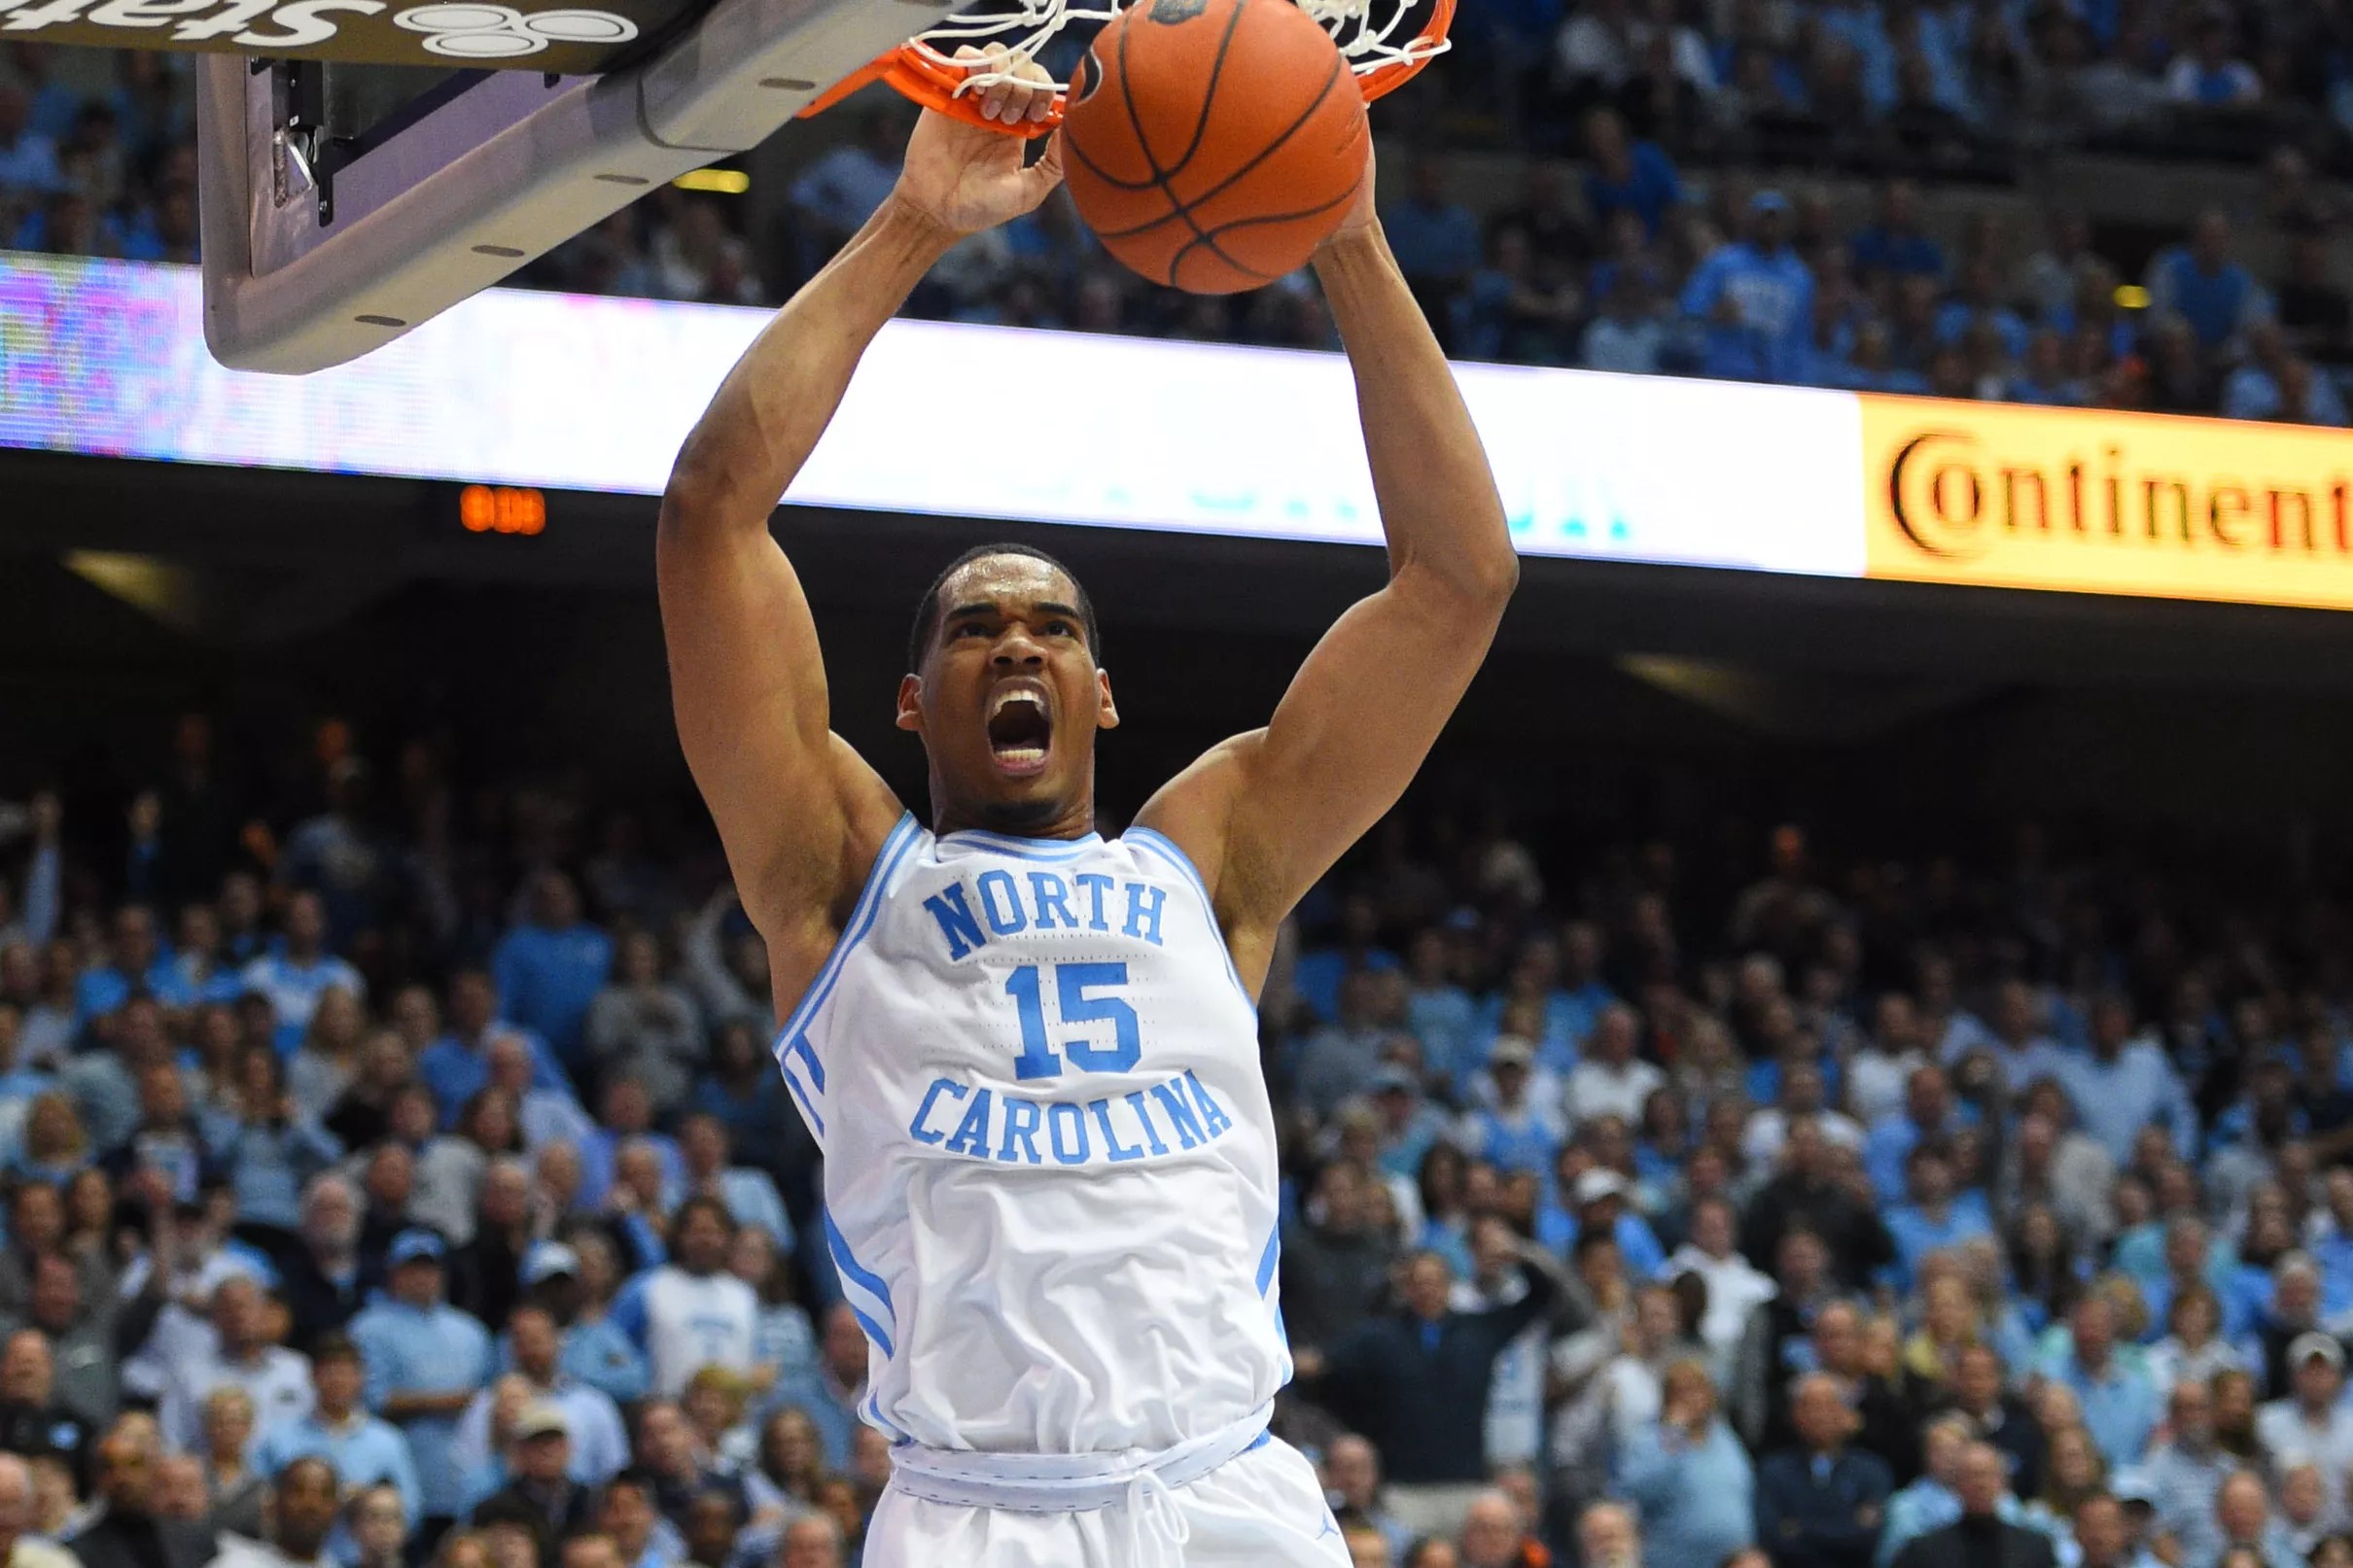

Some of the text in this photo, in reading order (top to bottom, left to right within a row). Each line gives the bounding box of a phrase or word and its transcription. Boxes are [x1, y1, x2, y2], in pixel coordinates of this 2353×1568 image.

[0, 0, 387, 47] Stat
[924, 869, 1167, 961] NORTH
[1005, 962, 1141, 1081] 15
[909, 1068, 1232, 1165] CAROLINA
